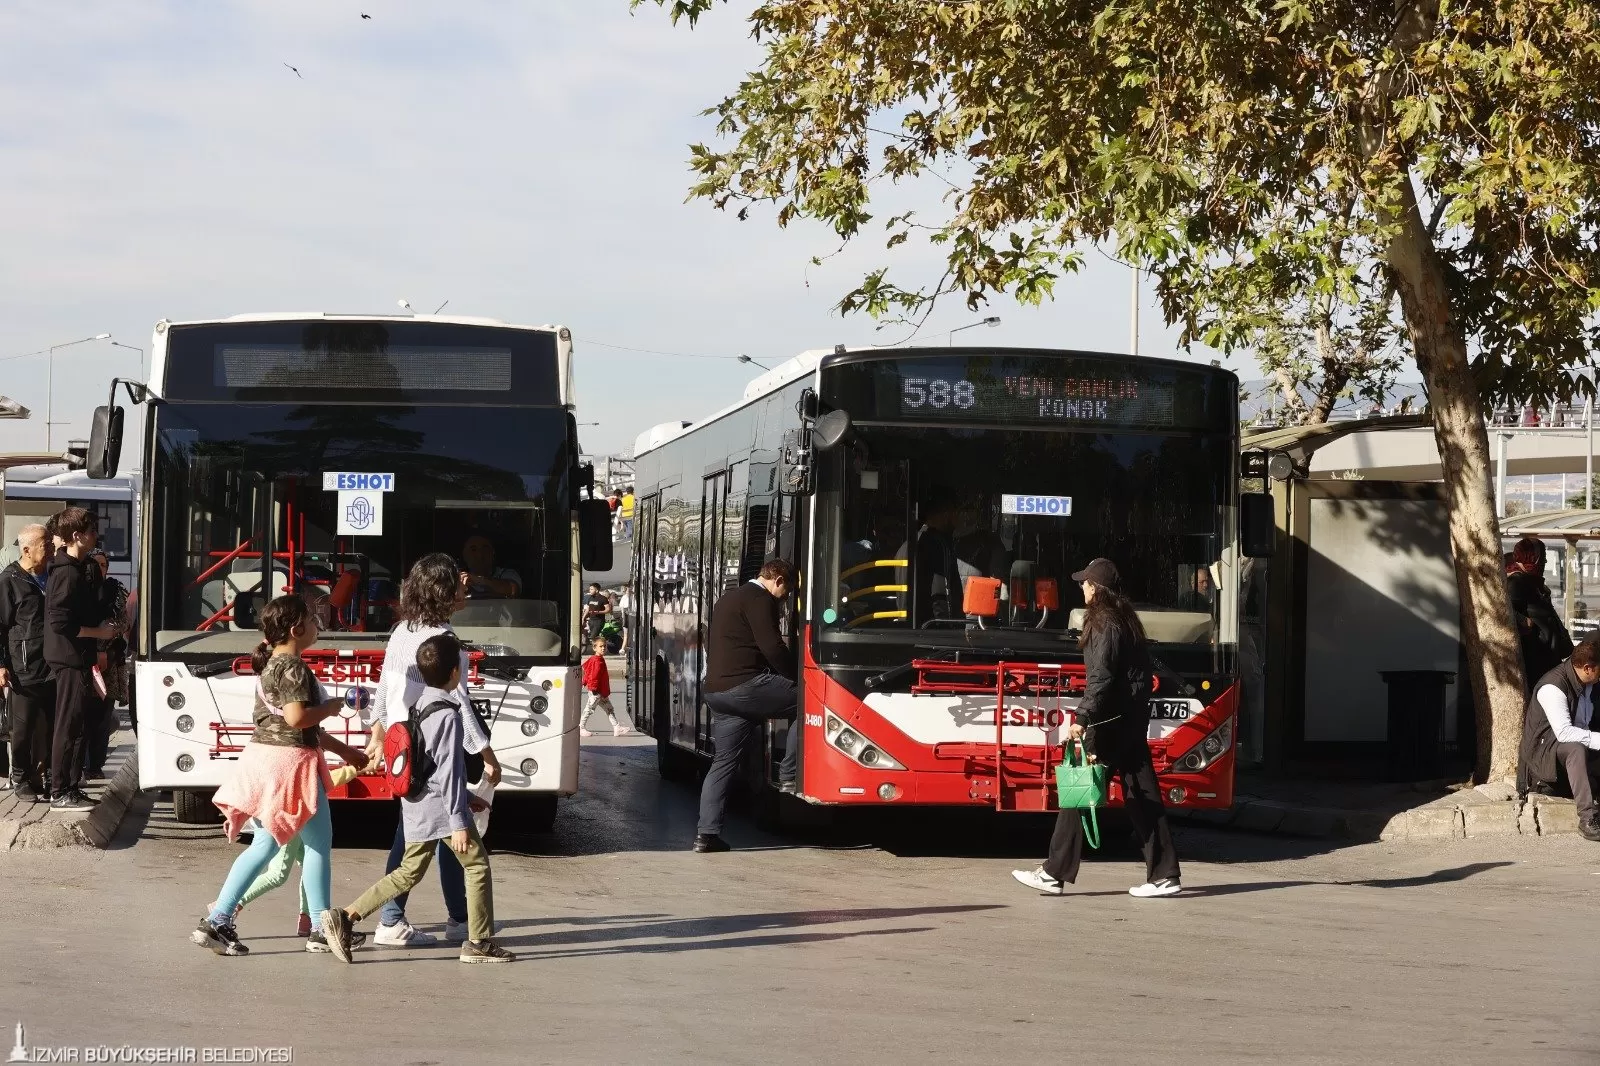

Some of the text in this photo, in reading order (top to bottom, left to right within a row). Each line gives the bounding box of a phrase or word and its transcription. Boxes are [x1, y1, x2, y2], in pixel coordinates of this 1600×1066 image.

[904, 378, 975, 409] 588
[1039, 398, 1107, 419] KONAK
[337, 473, 392, 490] ESHOT
[1016, 496, 1069, 513] ESHOT
[993, 708, 1077, 728] ESHOT
[1163, 703, 1188, 719] 376
